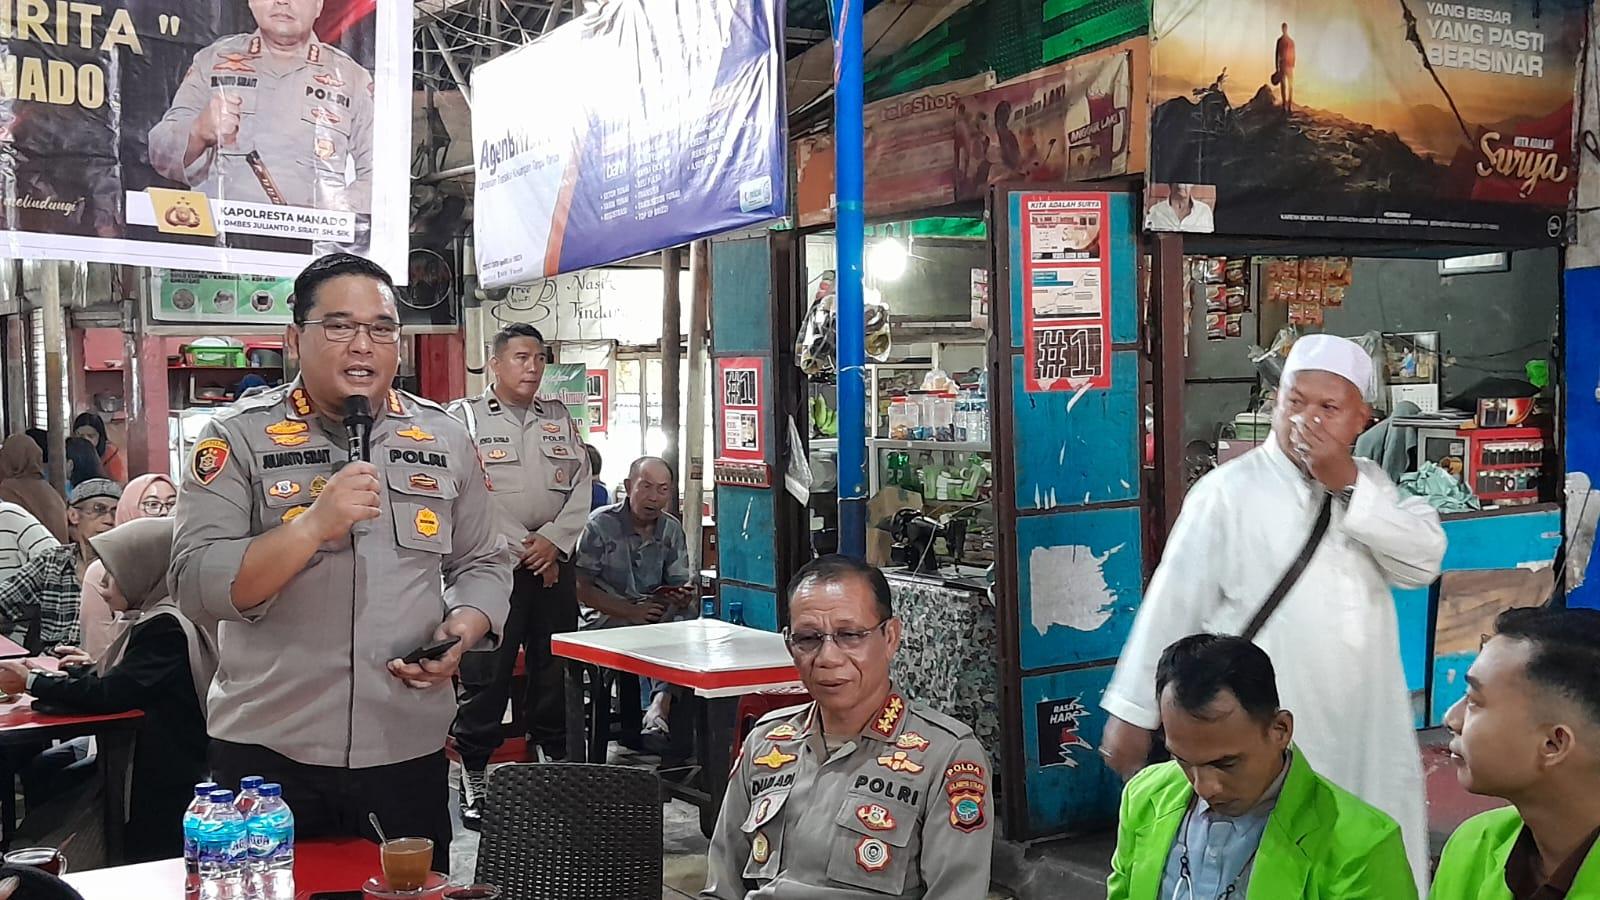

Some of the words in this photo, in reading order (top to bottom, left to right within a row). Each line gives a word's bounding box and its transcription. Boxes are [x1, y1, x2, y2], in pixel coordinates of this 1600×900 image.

[1426, 2, 1465, 18] YANG
[1466, 7, 1512, 25] BESAR
[1426, 19, 1483, 45] YANG
[1488, 26, 1544, 52] PASTI
[1427, 43, 1543, 78] BERSINAR
[306, 86, 350, 108] POLRI
[1476, 131, 1568, 198] Surya
[221, 206, 294, 222] KAPOLRESTA
[296, 213, 348, 227] MANADO
[1037, 329, 1095, 380] #1
[728, 371, 753, 405] #1
[390, 449, 448, 468] POLRI
[946, 763, 981, 776] POLDA
[855, 774, 919, 806] POLRI
